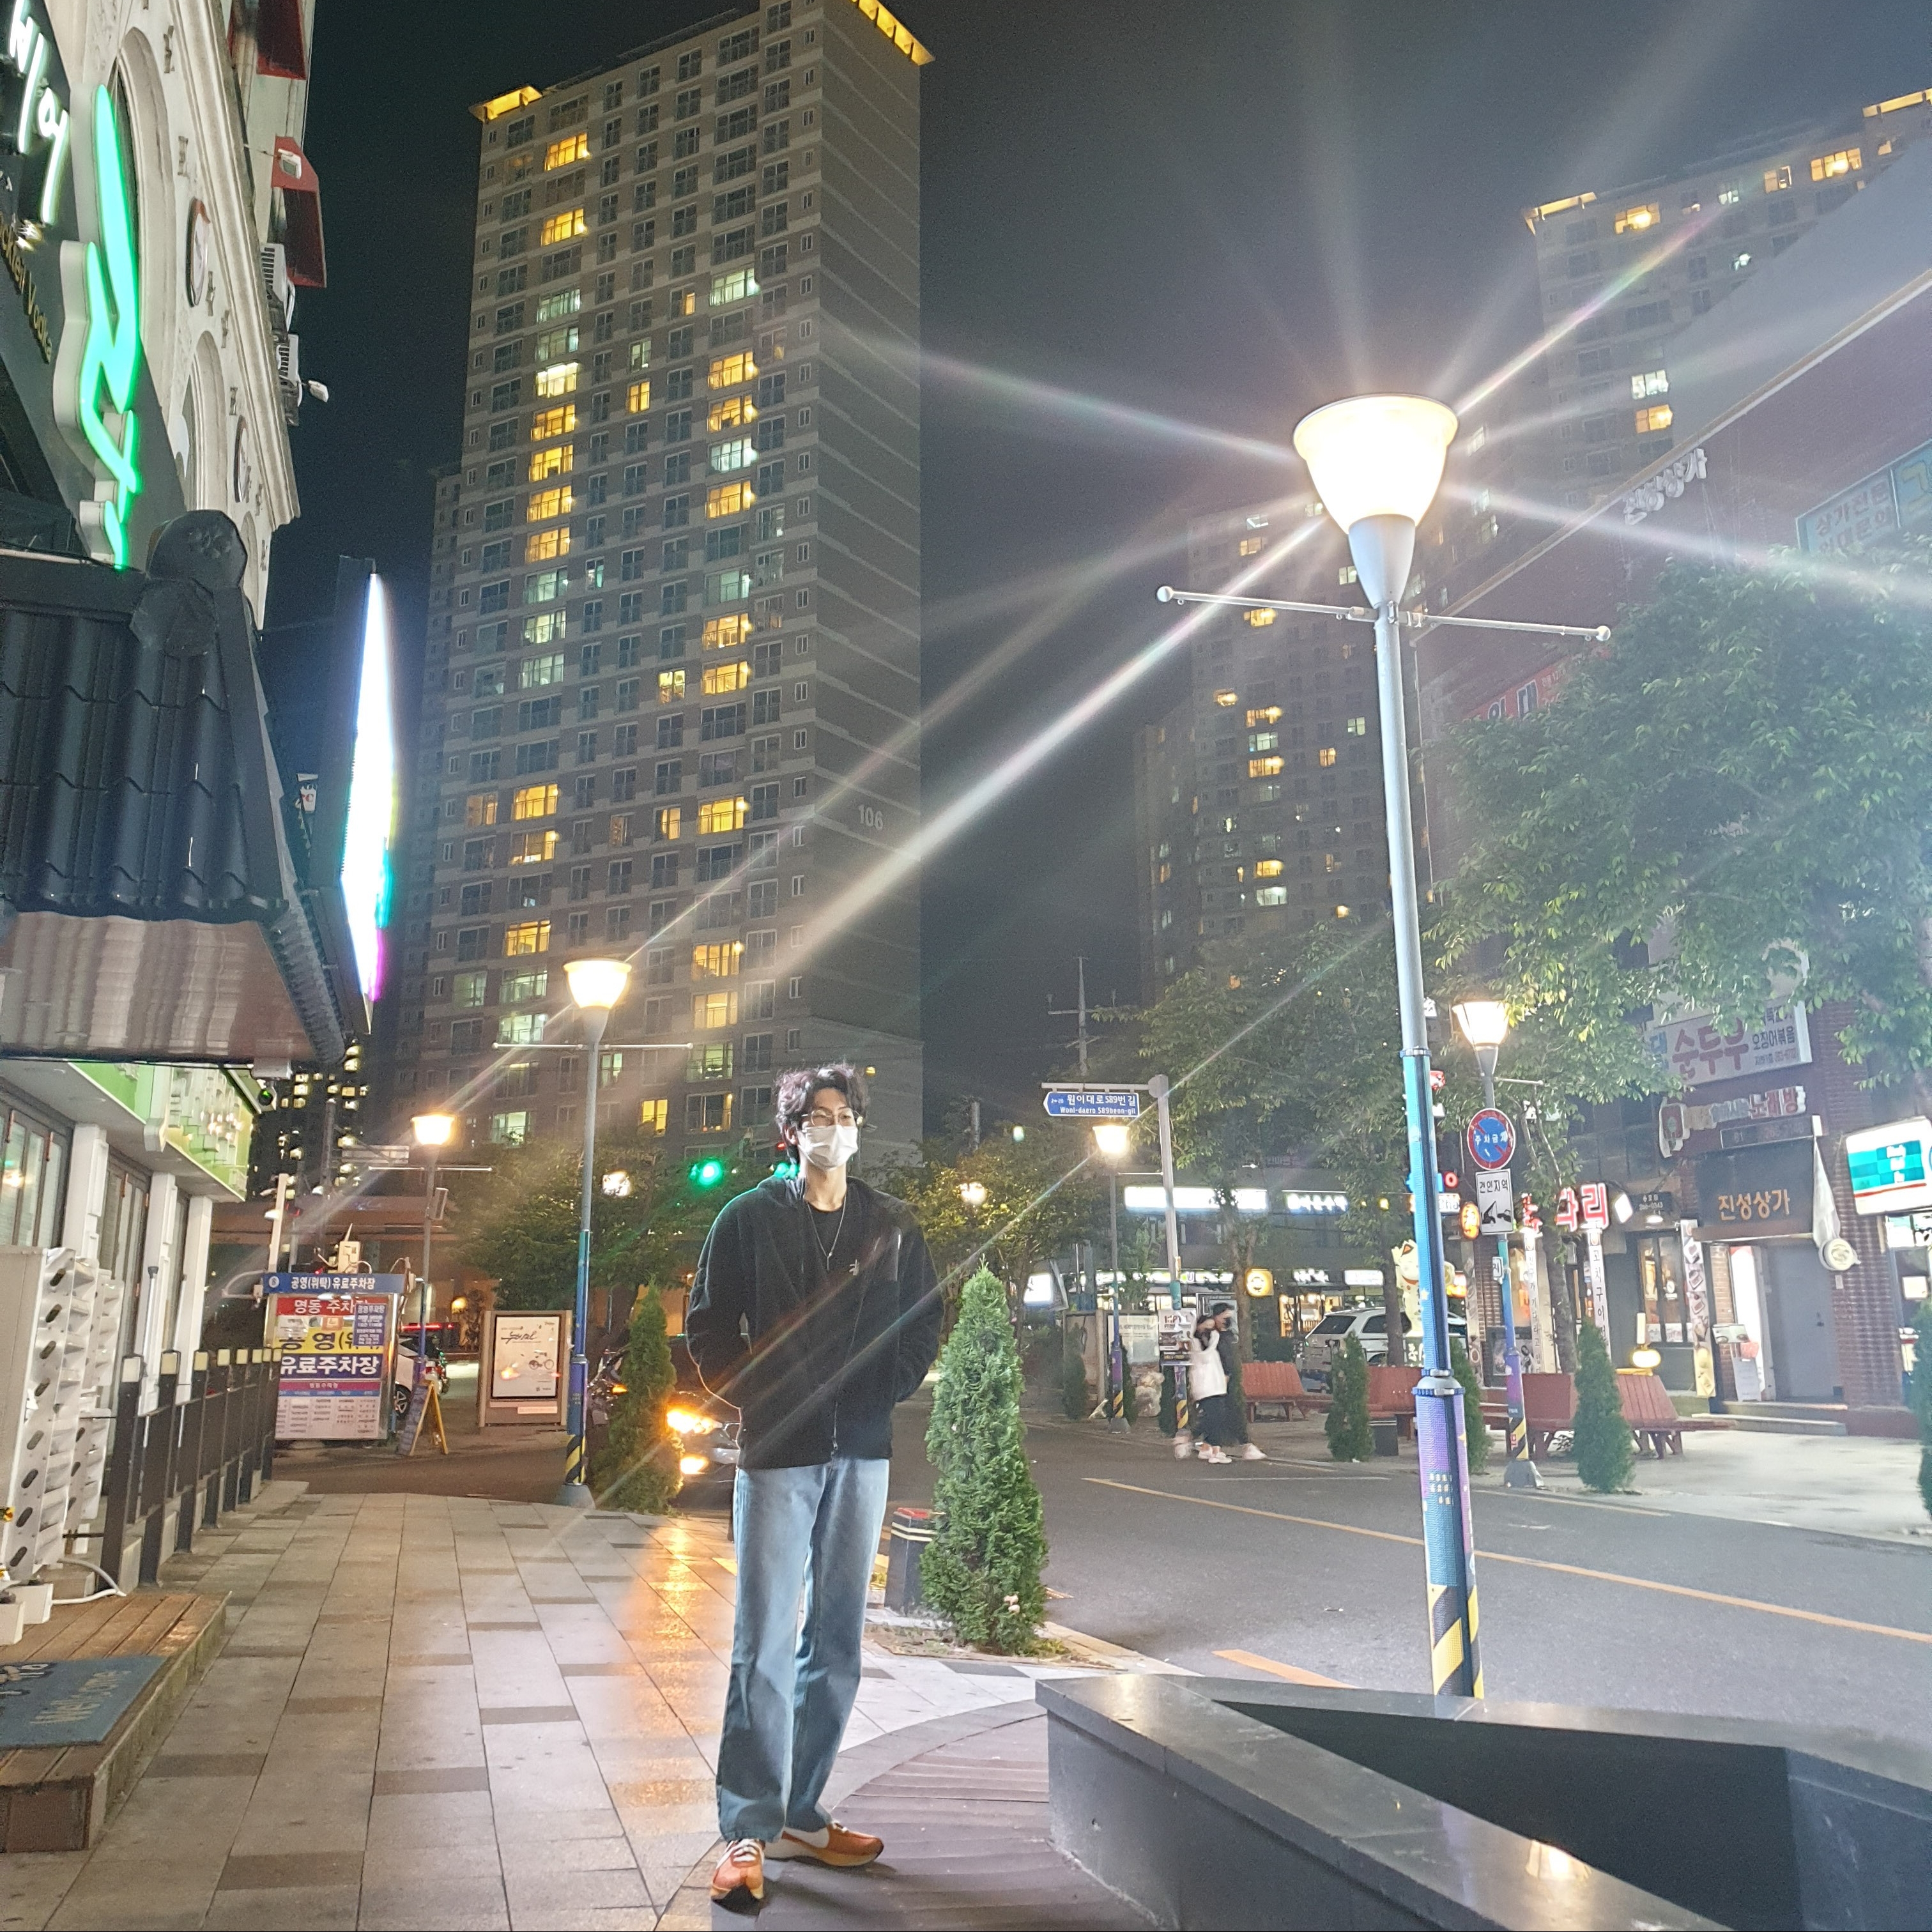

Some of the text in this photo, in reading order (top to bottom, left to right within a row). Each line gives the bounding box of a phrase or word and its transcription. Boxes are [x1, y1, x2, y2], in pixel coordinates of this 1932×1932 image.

[858, 804, 884, 831] 106
[1067, 1094, 1135, 1107] 원이대로589번길
[1749, 1086, 1799, 1119] 노래방
[1479, 1179, 1508, 1193] 견인지역
[1718, 1188, 1790, 1221] 진성상가
[291, 1276, 376, 1290] 공영(위탁) 유료주차장
[295, 1300, 322, 1314] 명동
[280, 1356, 379, 1375] 유료주차장
